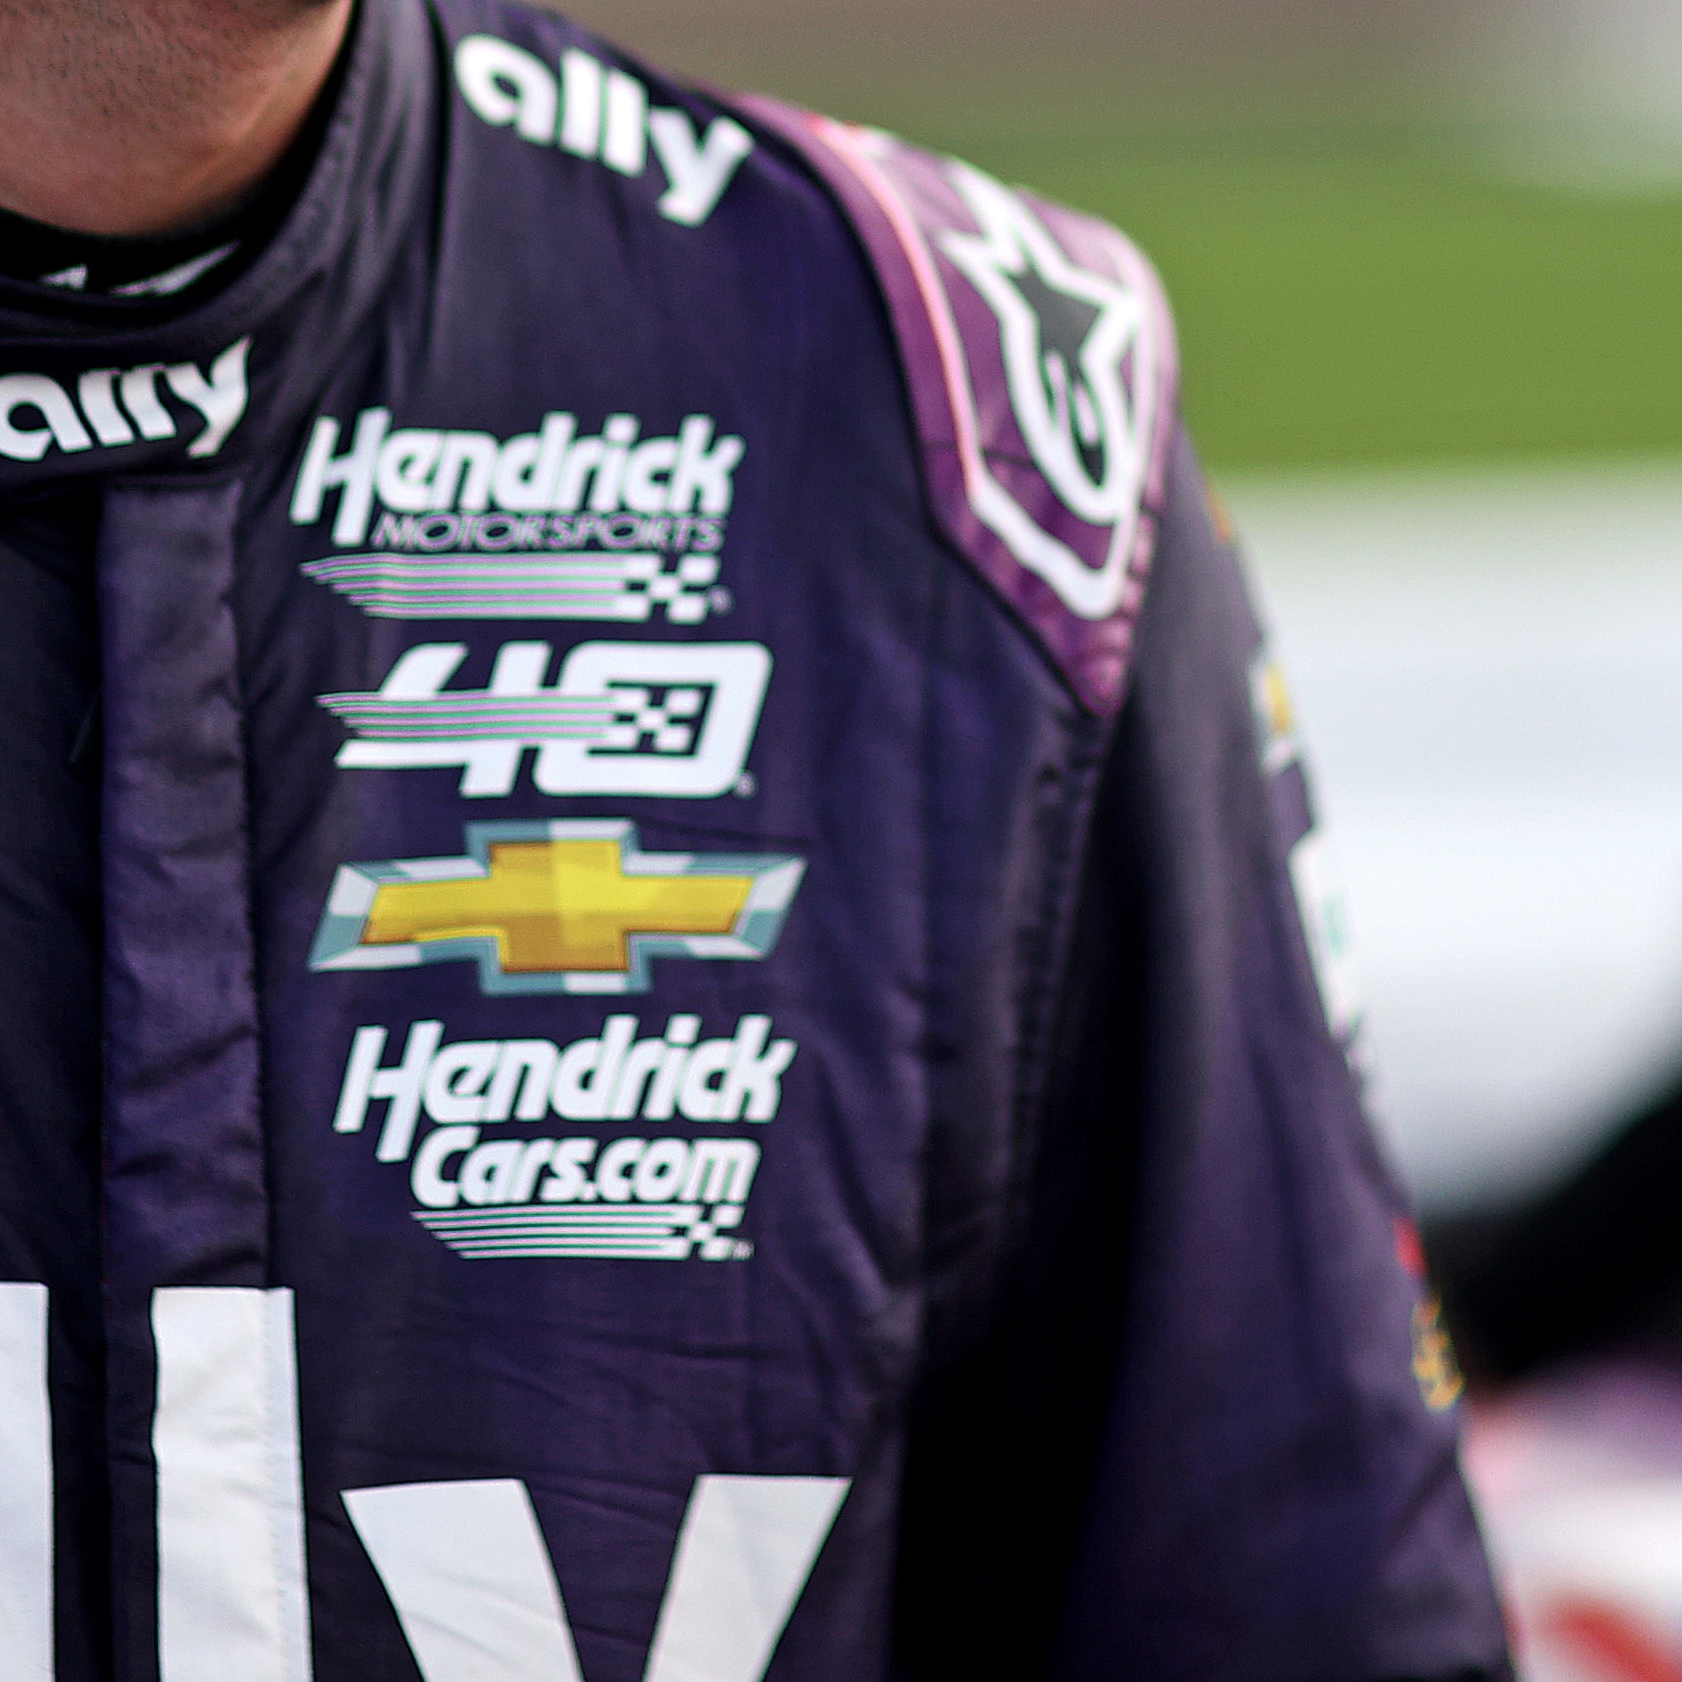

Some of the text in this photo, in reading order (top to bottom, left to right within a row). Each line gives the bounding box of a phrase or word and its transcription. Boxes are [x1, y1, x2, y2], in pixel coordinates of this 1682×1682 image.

[455, 35, 754, 225] ally
[291, 407, 746, 546] Hendrick
[371, 512, 724, 552] MOTORSPORTS
[334, 1015, 796, 1161] Hendrick
[410, 1126, 760, 1205] Cars.com
